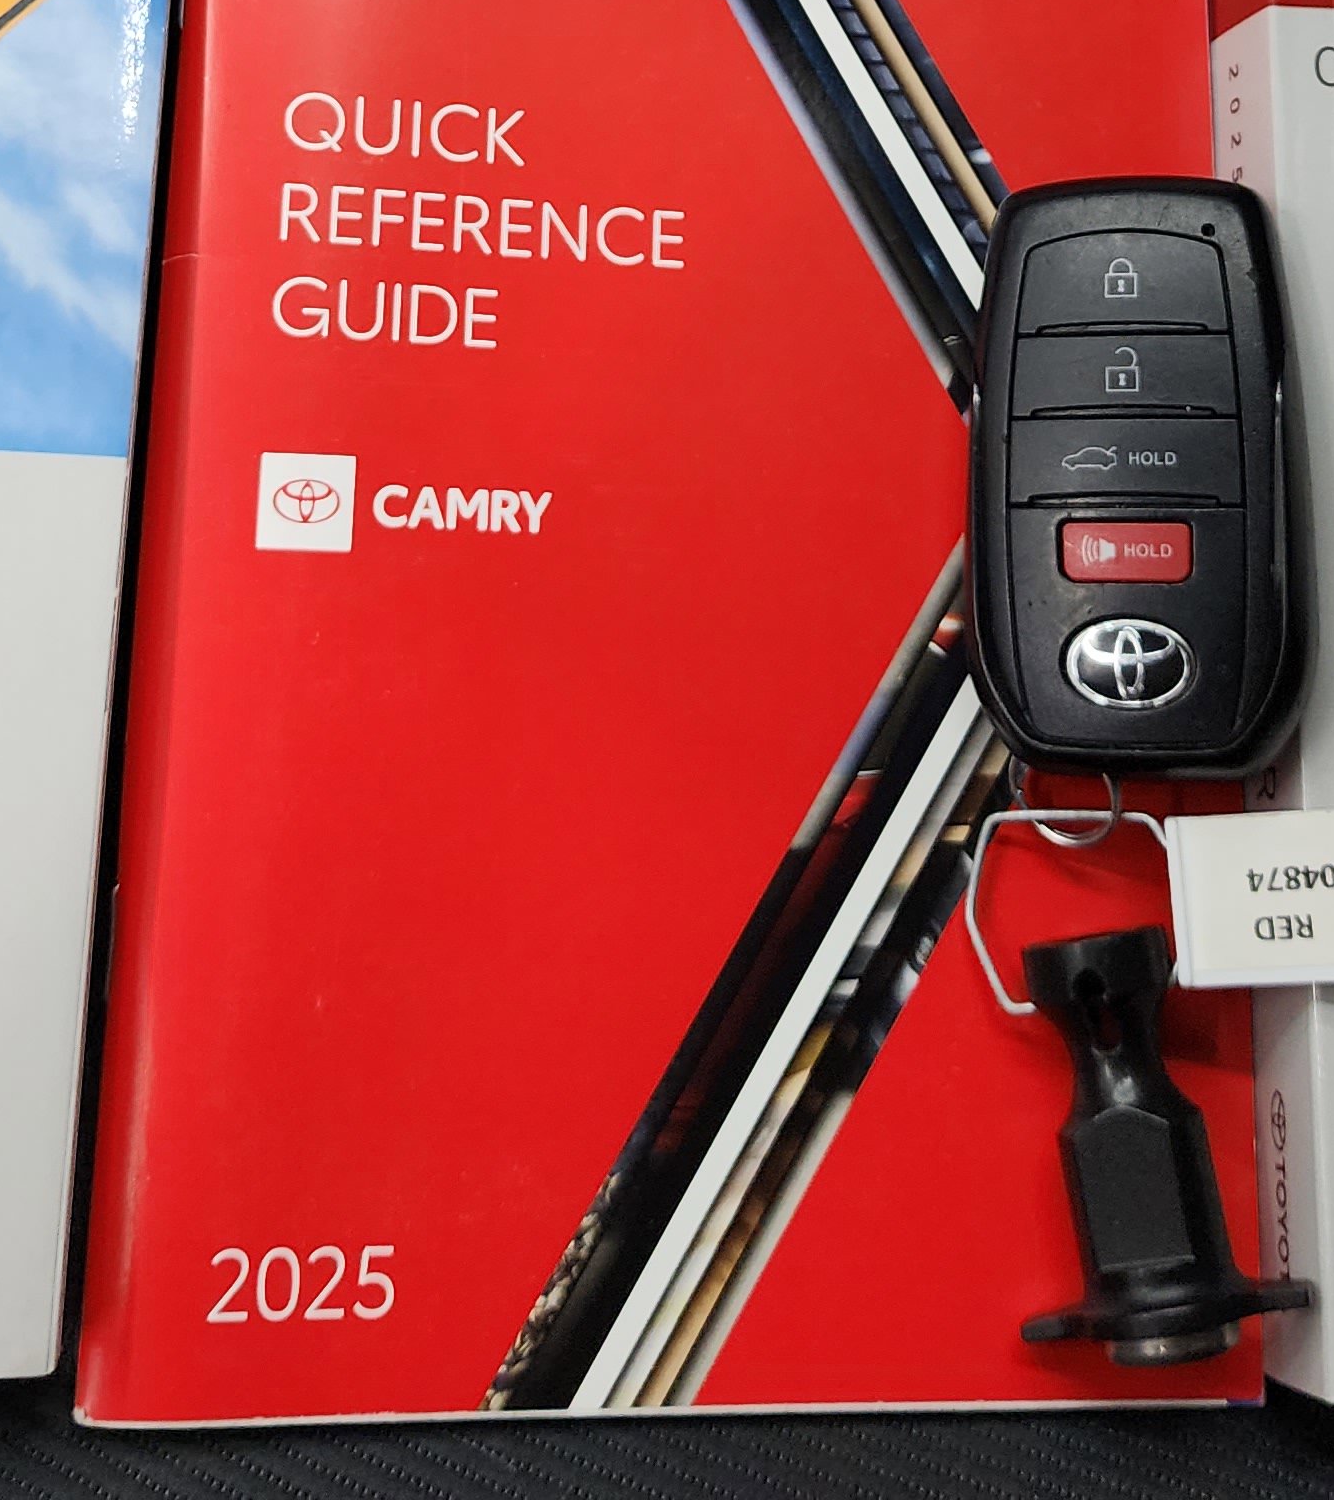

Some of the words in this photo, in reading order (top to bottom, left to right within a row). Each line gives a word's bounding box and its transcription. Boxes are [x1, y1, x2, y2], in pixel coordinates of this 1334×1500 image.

[283, 91, 525, 167] QUICK
[278, 182, 685, 270] REFERENCE
[272, 276, 499, 349] GUIDE
[1128, 450, 1177, 466] HOLD
[371, 484, 553, 535] CAMRY
[1122, 542, 1173, 559] HOLD
[1254, 913, 1314, 940] RED
[205, 1244, 395, 1323] 2025
